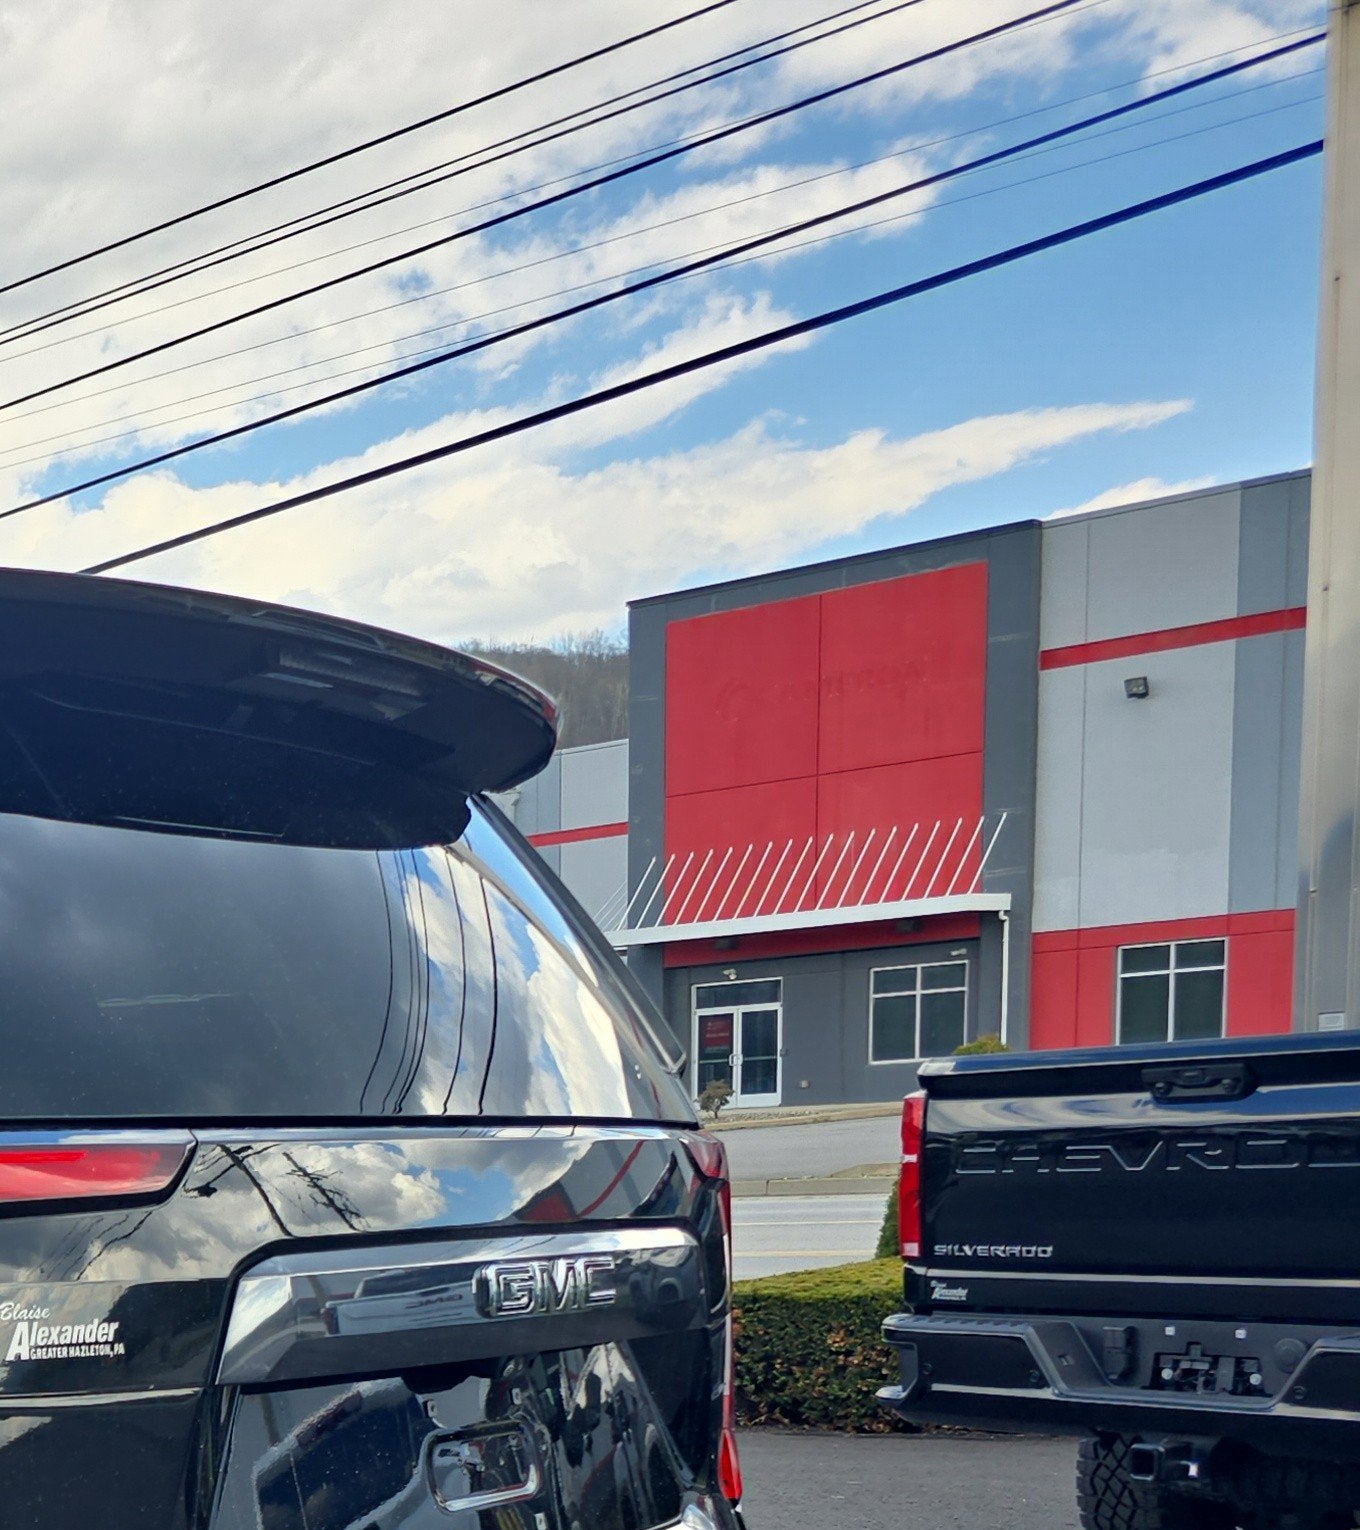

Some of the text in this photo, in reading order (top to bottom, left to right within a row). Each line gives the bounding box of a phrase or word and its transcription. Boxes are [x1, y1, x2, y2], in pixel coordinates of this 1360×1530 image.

[934, 1245, 1053, 1257] SILVERADO
[490, 1256, 616, 1316] GMC
[0, 1302, 50, 1321] Blaise
[5, 1318, 120, 1361] Alexander
[30, 1342, 125, 1360] GREATER HAZLETON, PA
